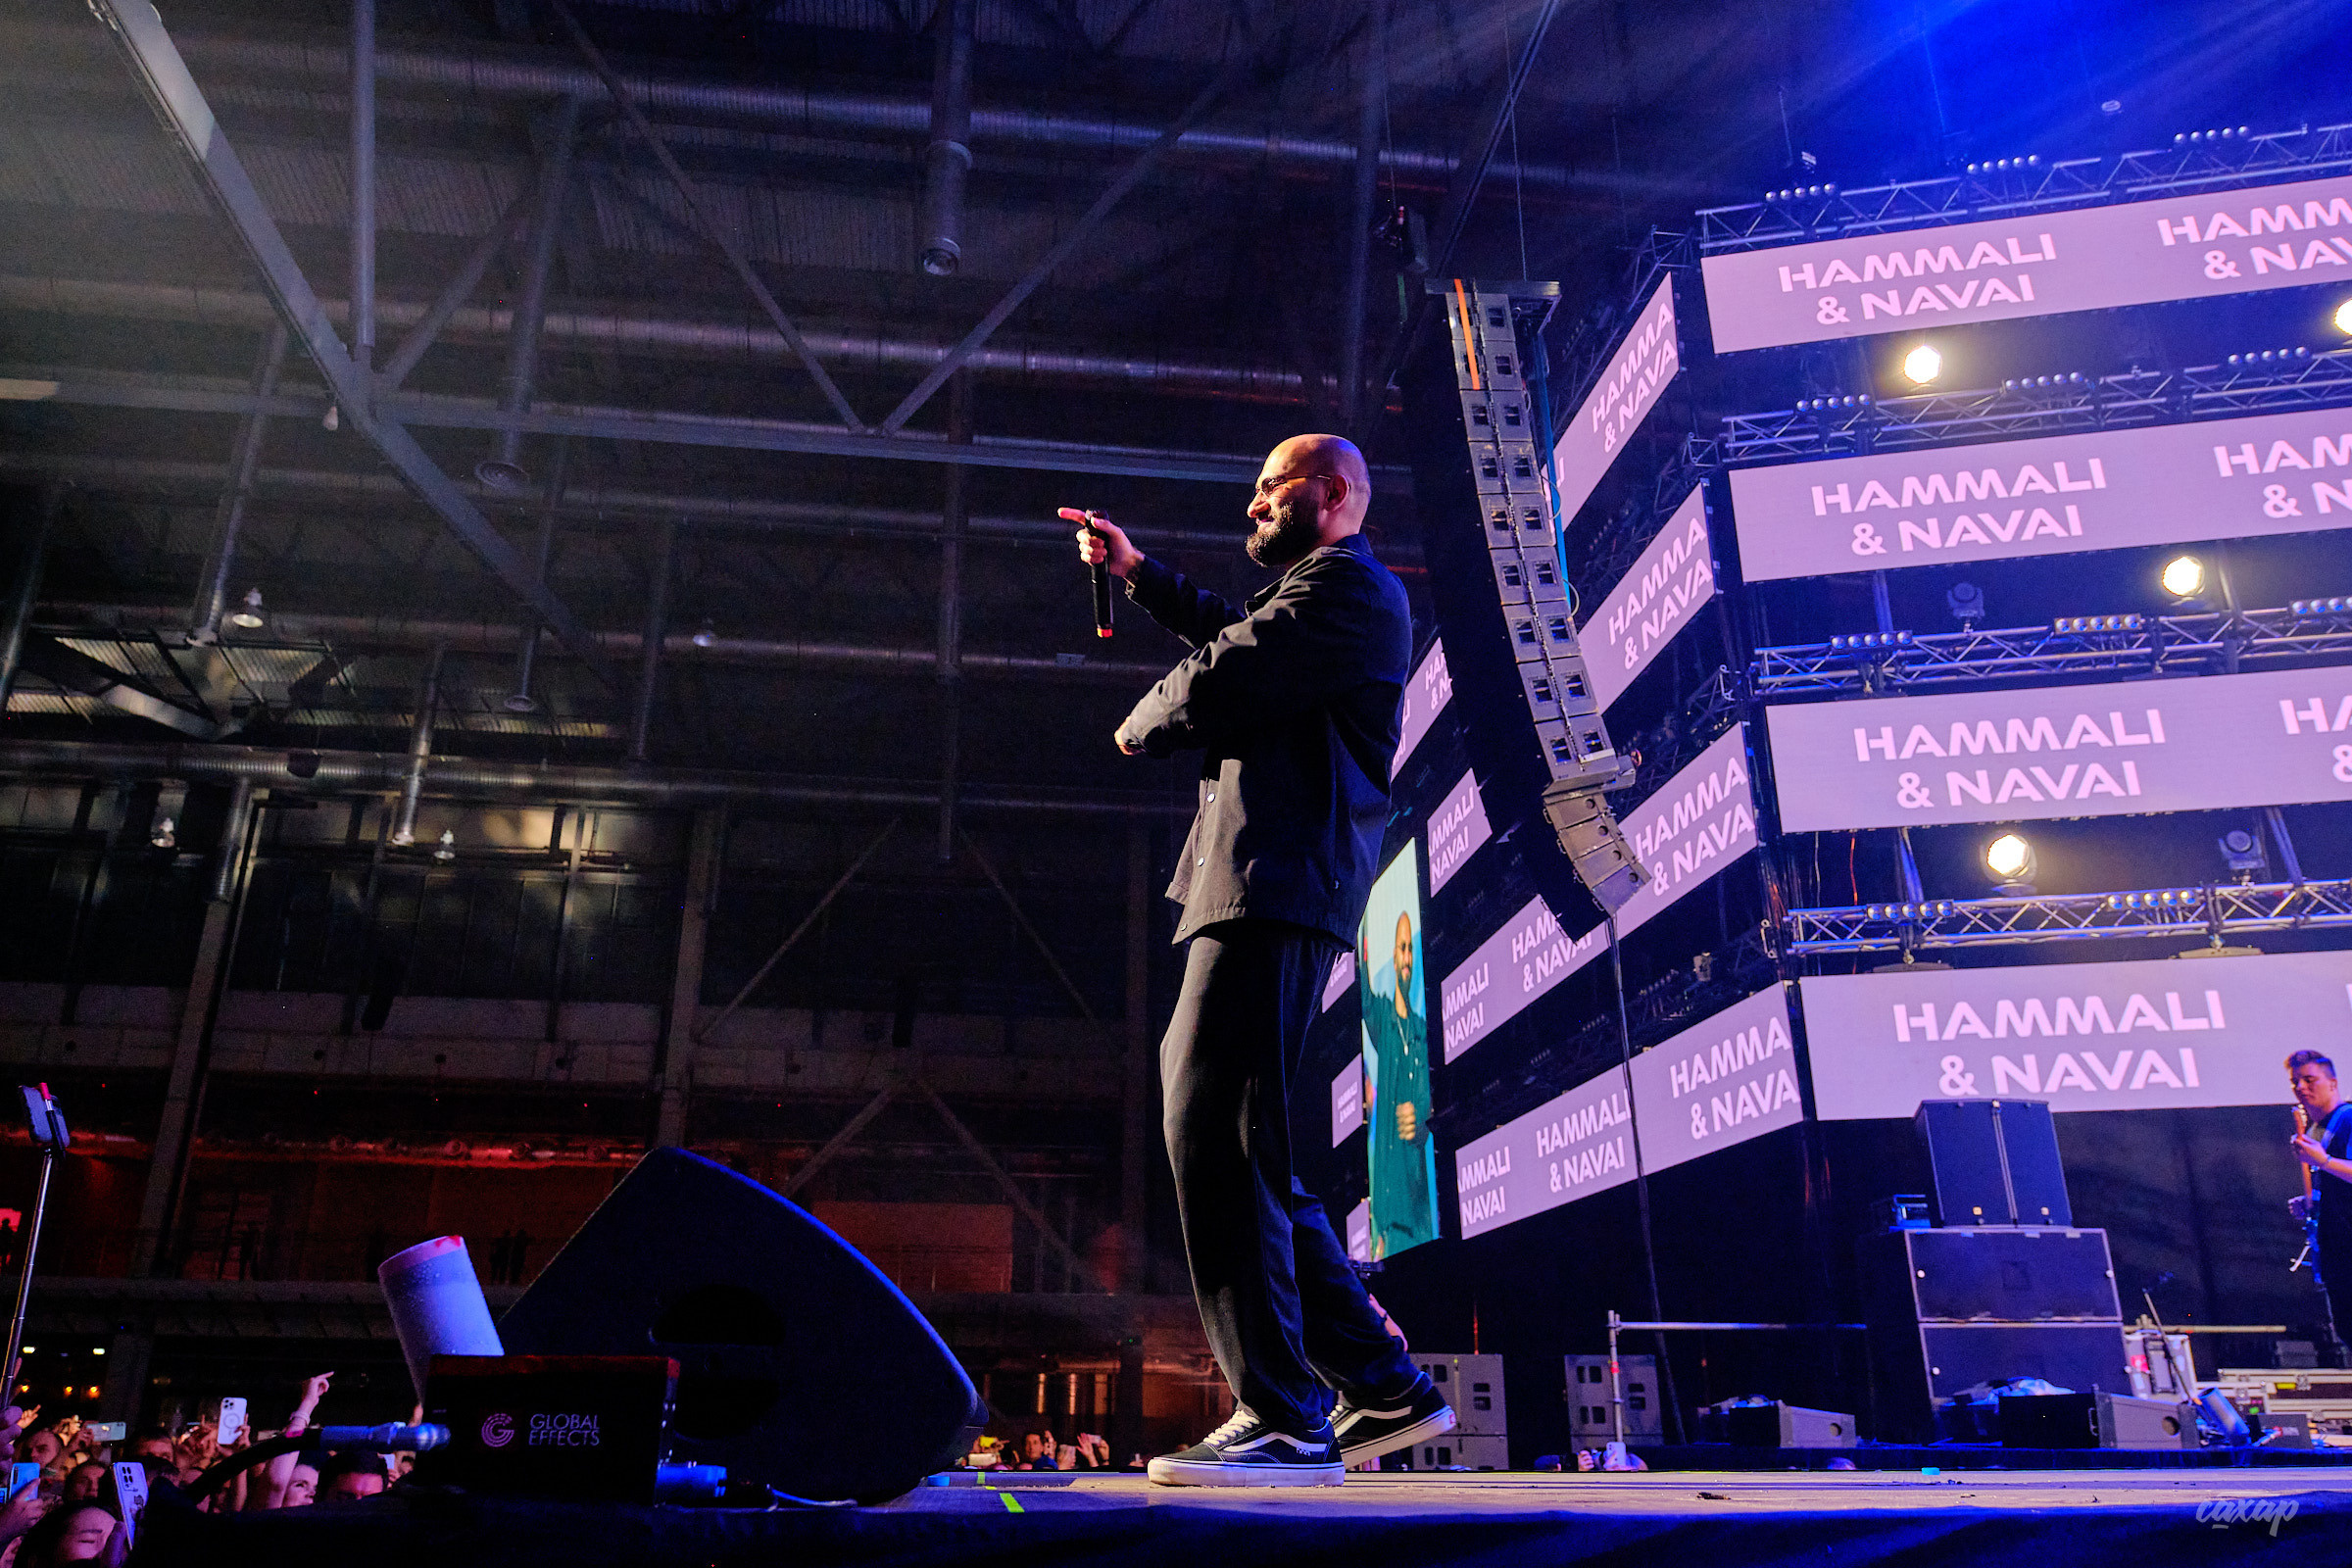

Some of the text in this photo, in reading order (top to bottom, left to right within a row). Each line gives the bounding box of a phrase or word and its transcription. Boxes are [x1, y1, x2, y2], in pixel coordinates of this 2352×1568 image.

[1778, 232, 2058, 293] HAMMALI
[2204, 250, 2242, 280] &
[1816, 273, 2035, 325] & NAVAI
[1592, 302, 1674, 434] HAMMA
[1604, 338, 1678, 454] & NAVA
[1811, 457, 2107, 516] HAMMALI
[2263, 483, 2303, 518] &
[1851, 504, 2083, 556] & NAVAI
[1608, 517, 1708, 646] HAMMA
[1624, 558, 1714, 670] & NAVA
[1853, 709, 2167, 762] HAMMALI
[1635, 757, 1749, 863] HAMMA
[1896, 760, 2142, 809] & NAVAI
[1428, 786, 1475, 857] MMALI
[1432, 825, 1469, 885] NAVAI
[1653, 803, 1756, 897] & NAVA
[1511, 909, 1557, 964] HAM
[1443, 961, 1490, 1022] MMALI
[1523, 962, 1535, 993] &
[1445, 1002, 1484, 1053] NAVAI
[1892, 989, 2227, 1043] HAMMALI
[1669, 1016, 1792, 1099] HAMMA
[1938, 1048, 2200, 1097] & NAVAI
[1536, 1089, 1632, 1158] HAMMALI
[1690, 1068, 1801, 1140] & NAVA
[1457, 1146, 1511, 1194] MMALI
[1549, 1136, 1626, 1194] & NAVAI
[1461, 1186, 1506, 1227] NAVAI
[529, 1413, 600, 1430] GLOBAL
[529, 1431, 600, 1446] EFFECTS
